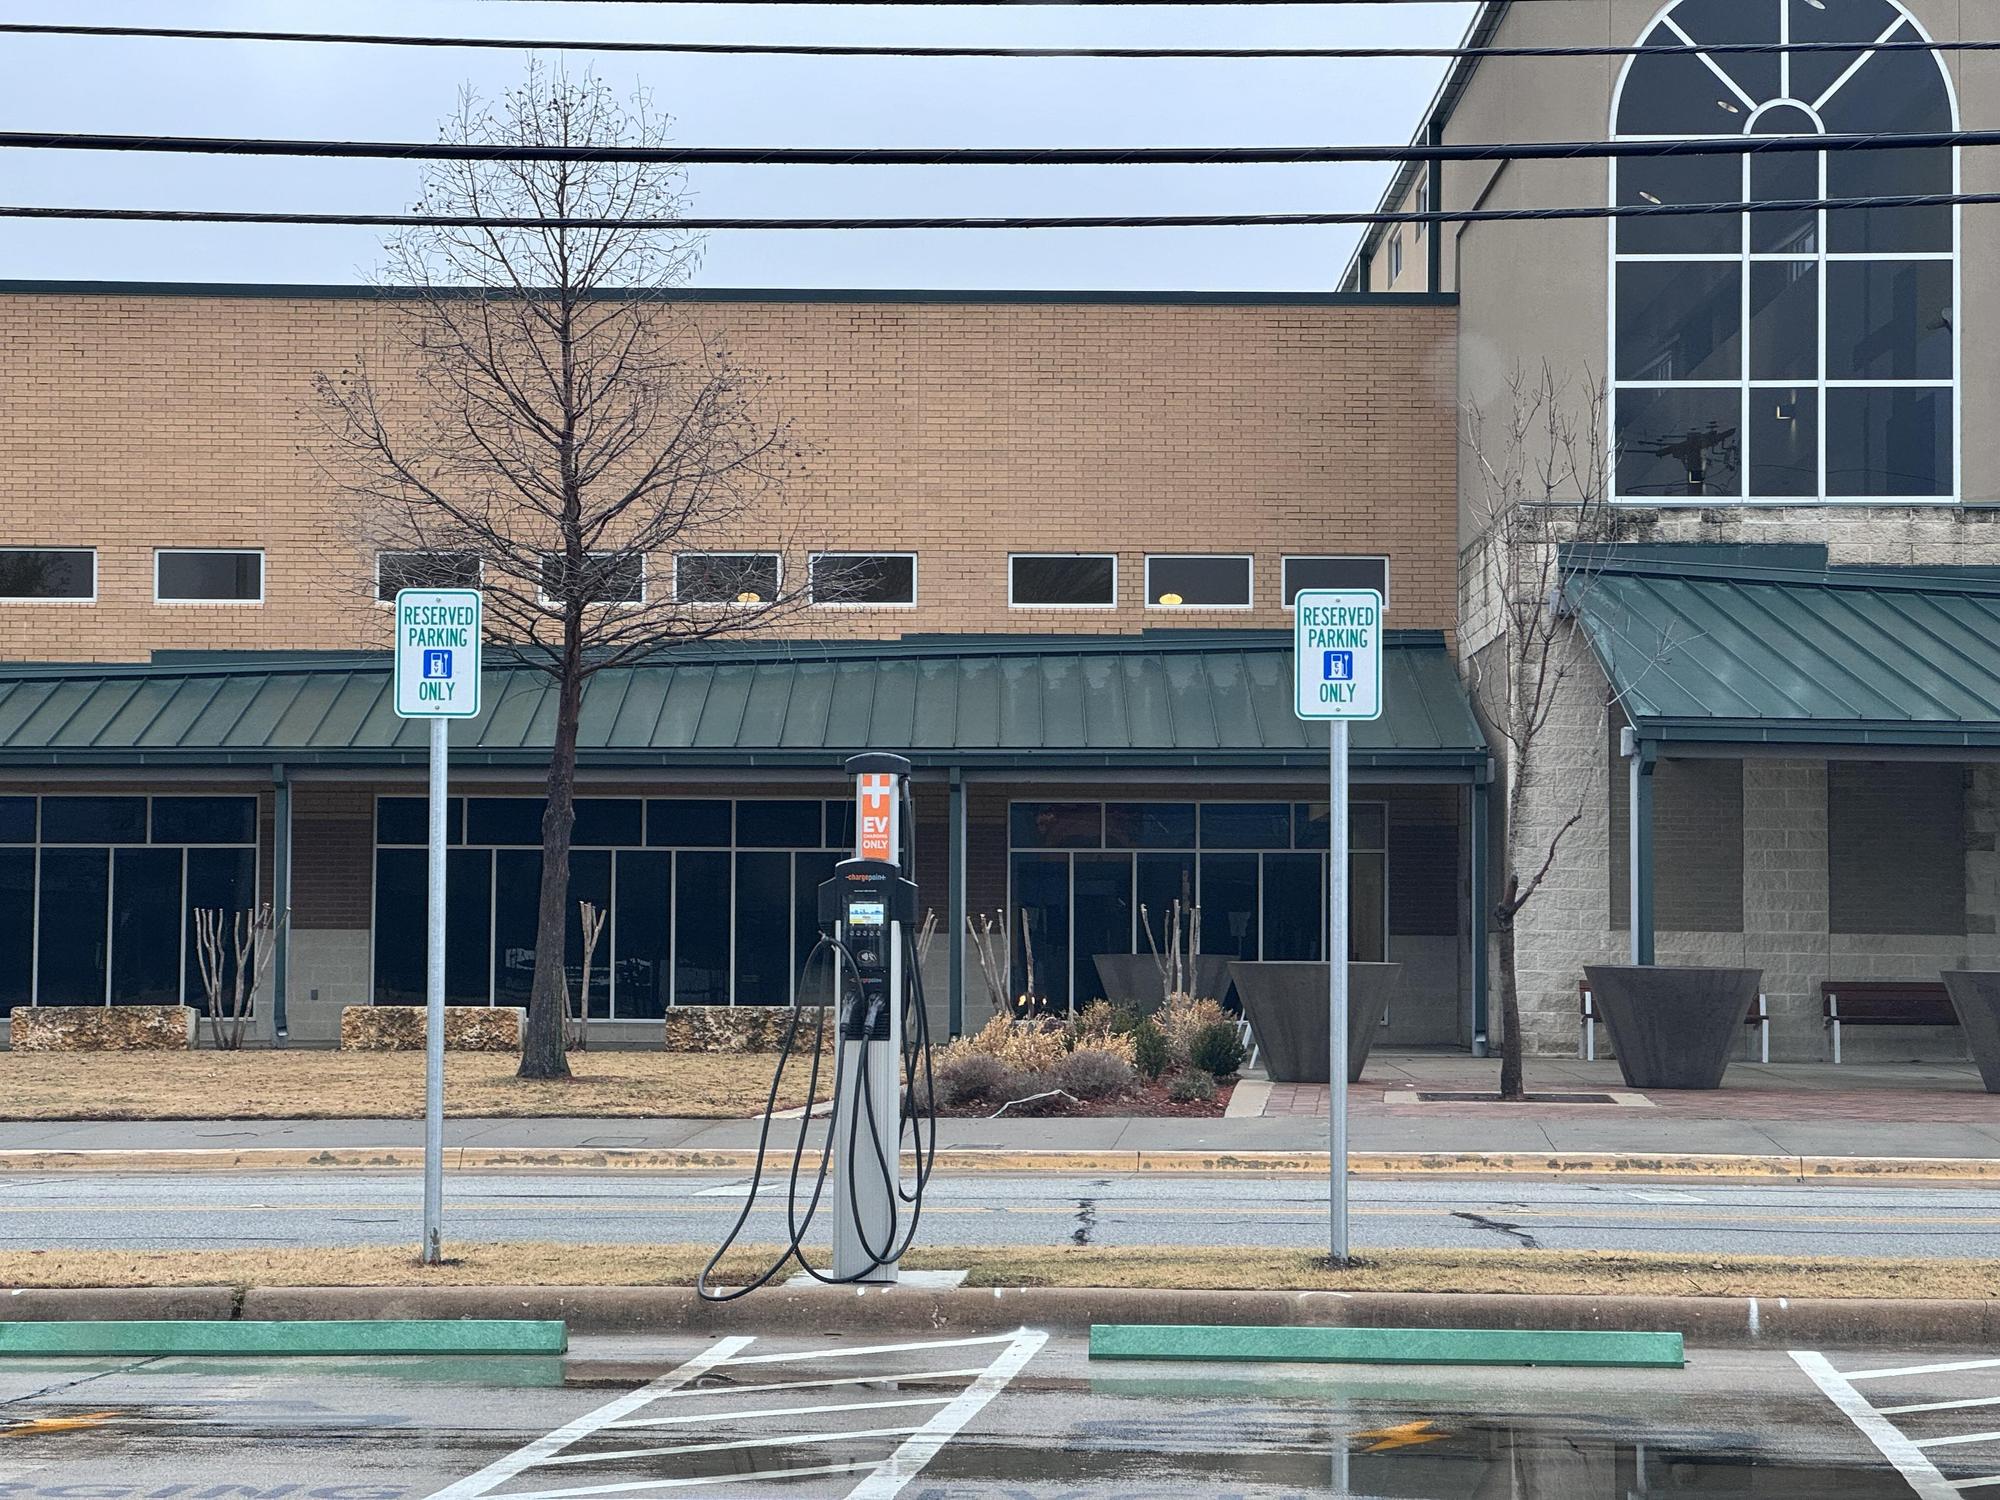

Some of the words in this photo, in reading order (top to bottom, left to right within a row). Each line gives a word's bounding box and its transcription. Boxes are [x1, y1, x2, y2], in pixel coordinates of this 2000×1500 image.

[404, 606, 474, 626] RESERVED
[1303, 606, 1374, 626] RESERVED
[409, 628, 468, 647] PARKING
[1308, 629, 1368, 648] PARKING
[419, 681, 455, 701] ONLY
[1320, 683, 1356, 703] ONLY
[863, 816, 889, 833] EV
[863, 840, 888, 849] ONLY
